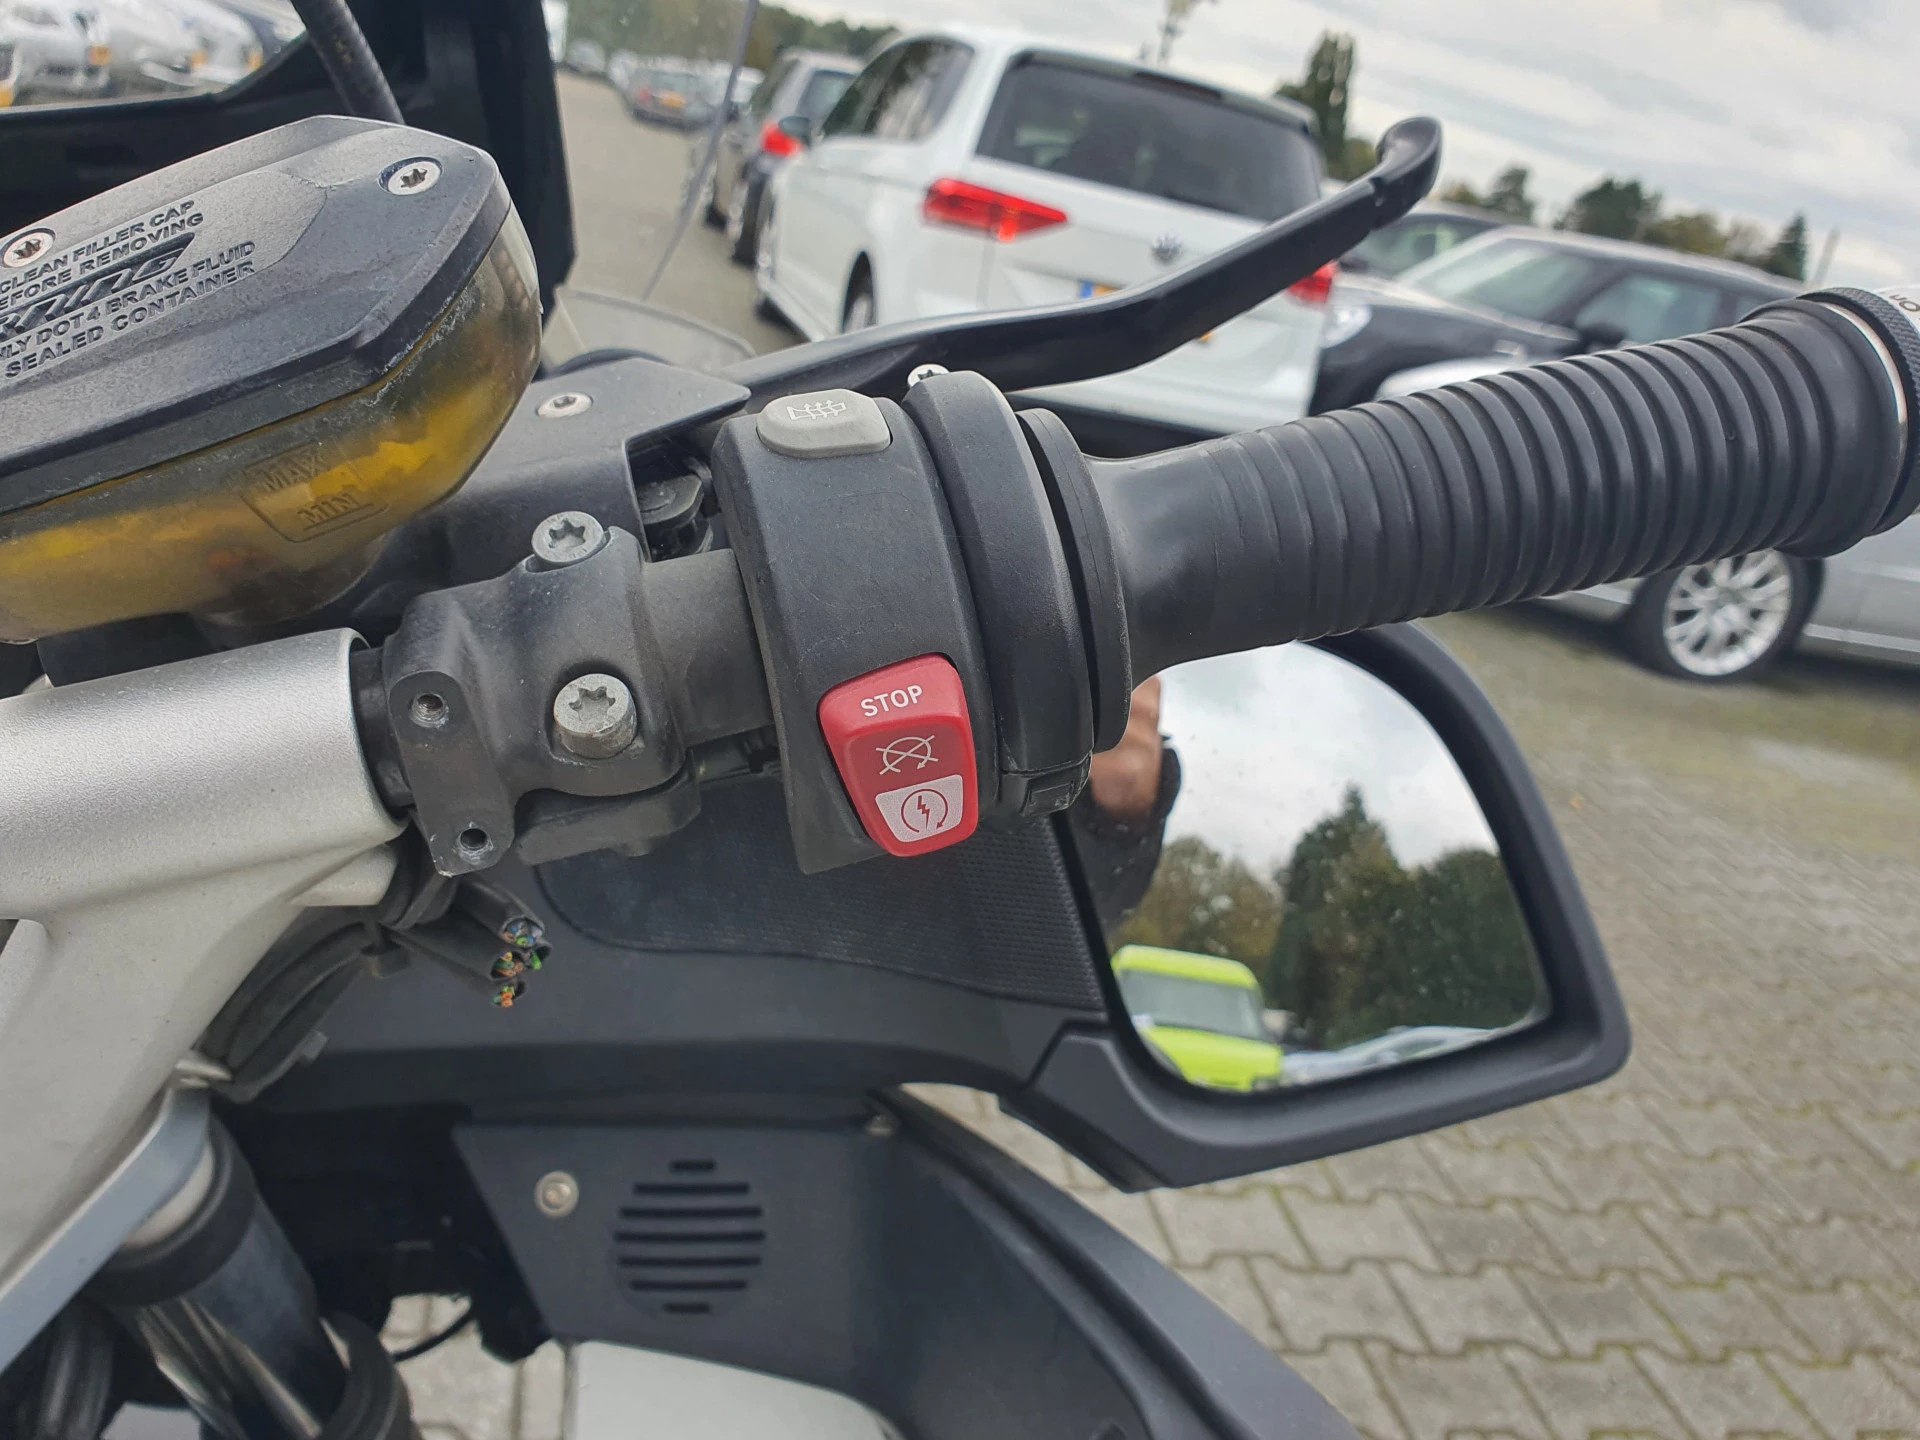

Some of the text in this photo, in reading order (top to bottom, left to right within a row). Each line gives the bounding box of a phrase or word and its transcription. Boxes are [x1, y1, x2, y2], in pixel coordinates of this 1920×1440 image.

[0, 200, 195, 294] CLEAN FILLER CAP
[79, 212, 204, 275] REMOVING
[5, 261, 255, 378] SEALED CONTAINER
[36, 312, 84, 345] DOT
[86, 305, 101, 321] 4
[105, 268, 188, 315] BRAKE
[192, 240, 256, 276] FLUID
[261, 452, 328, 491] MAX
[298, 491, 360, 525] MIN
[860, 684, 923, 717] STOP
